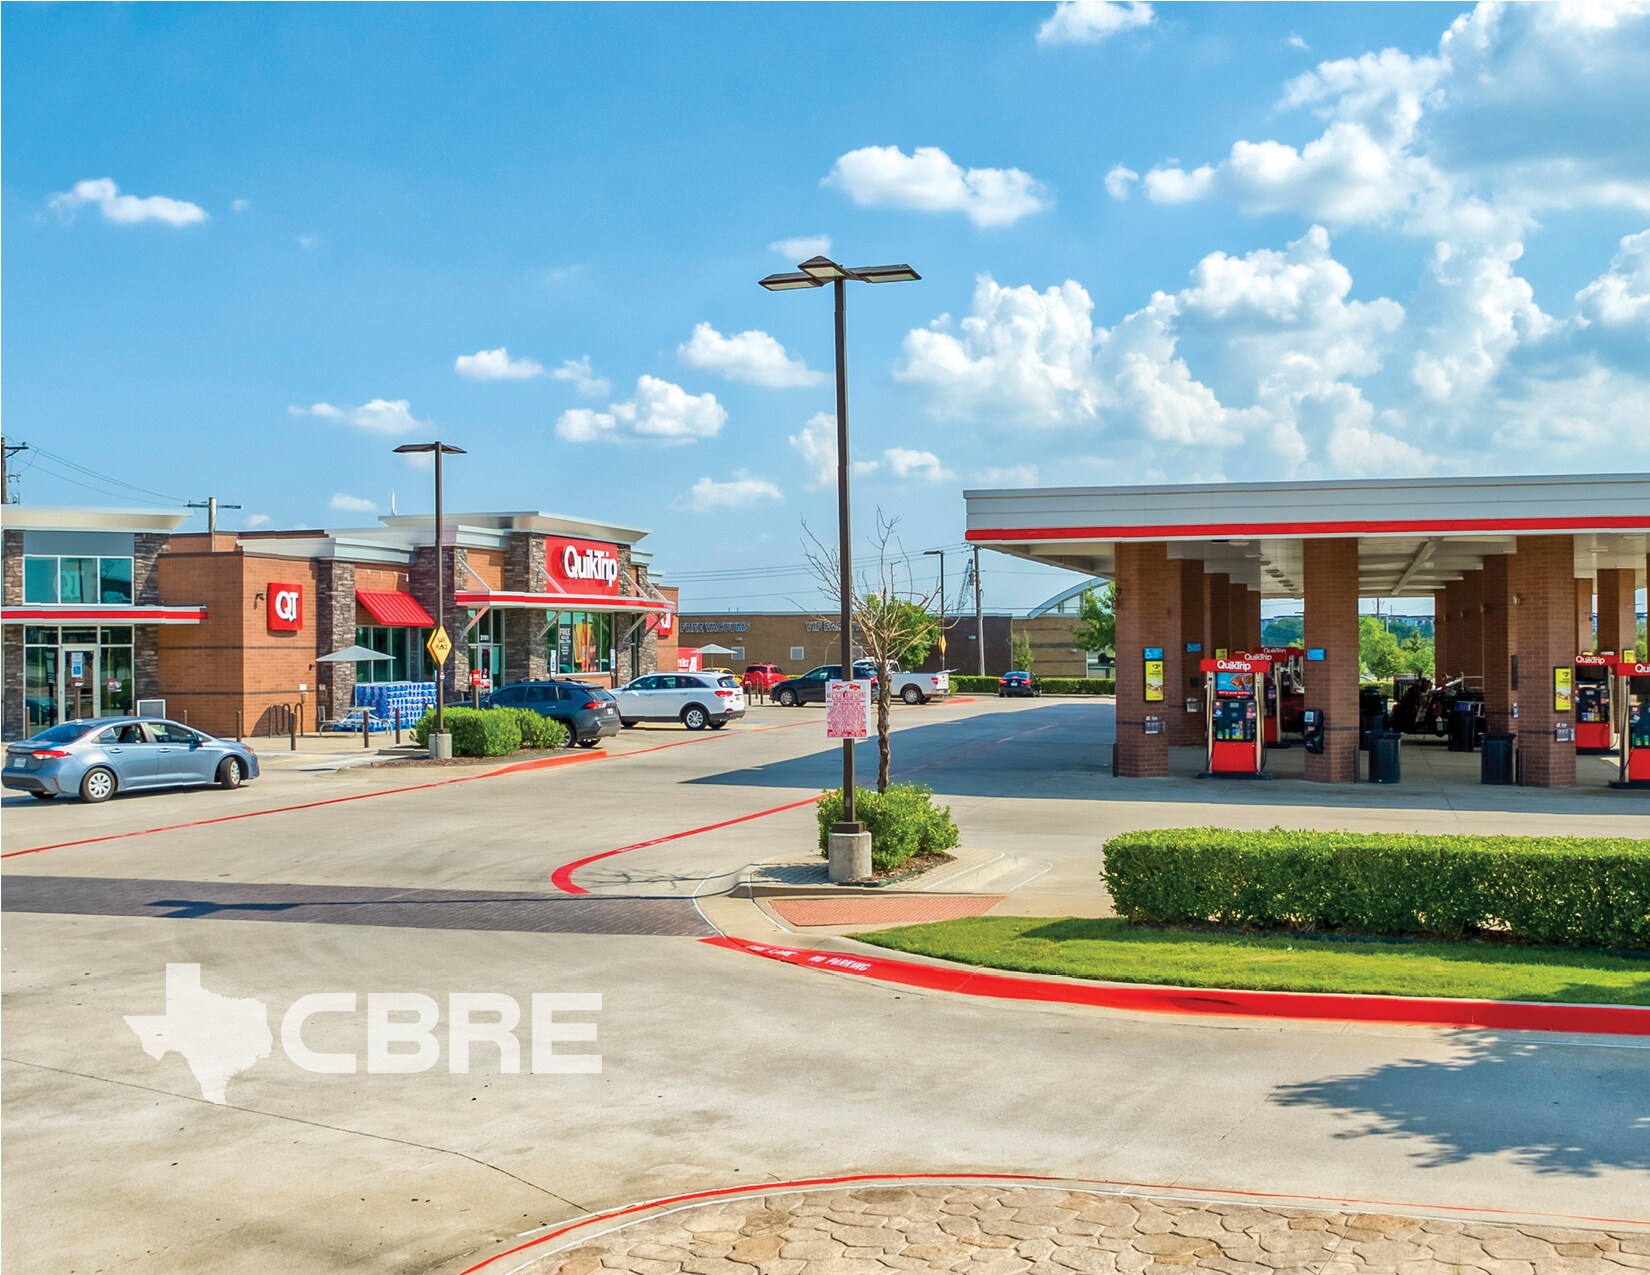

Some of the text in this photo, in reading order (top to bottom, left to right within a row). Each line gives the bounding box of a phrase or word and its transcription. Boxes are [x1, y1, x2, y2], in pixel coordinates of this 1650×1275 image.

[562, 545, 618, 587] QuikTrip
[275, 590, 299, 622] QT
[680, 621, 752, 633] FREE VACUUMS
[805, 620, 823, 632] VIP
[1216, 659, 1251, 671] QuikTrip
[1575, 655, 1606, 666] QuikTrip
[808, 955, 871, 971] NO PARKING
